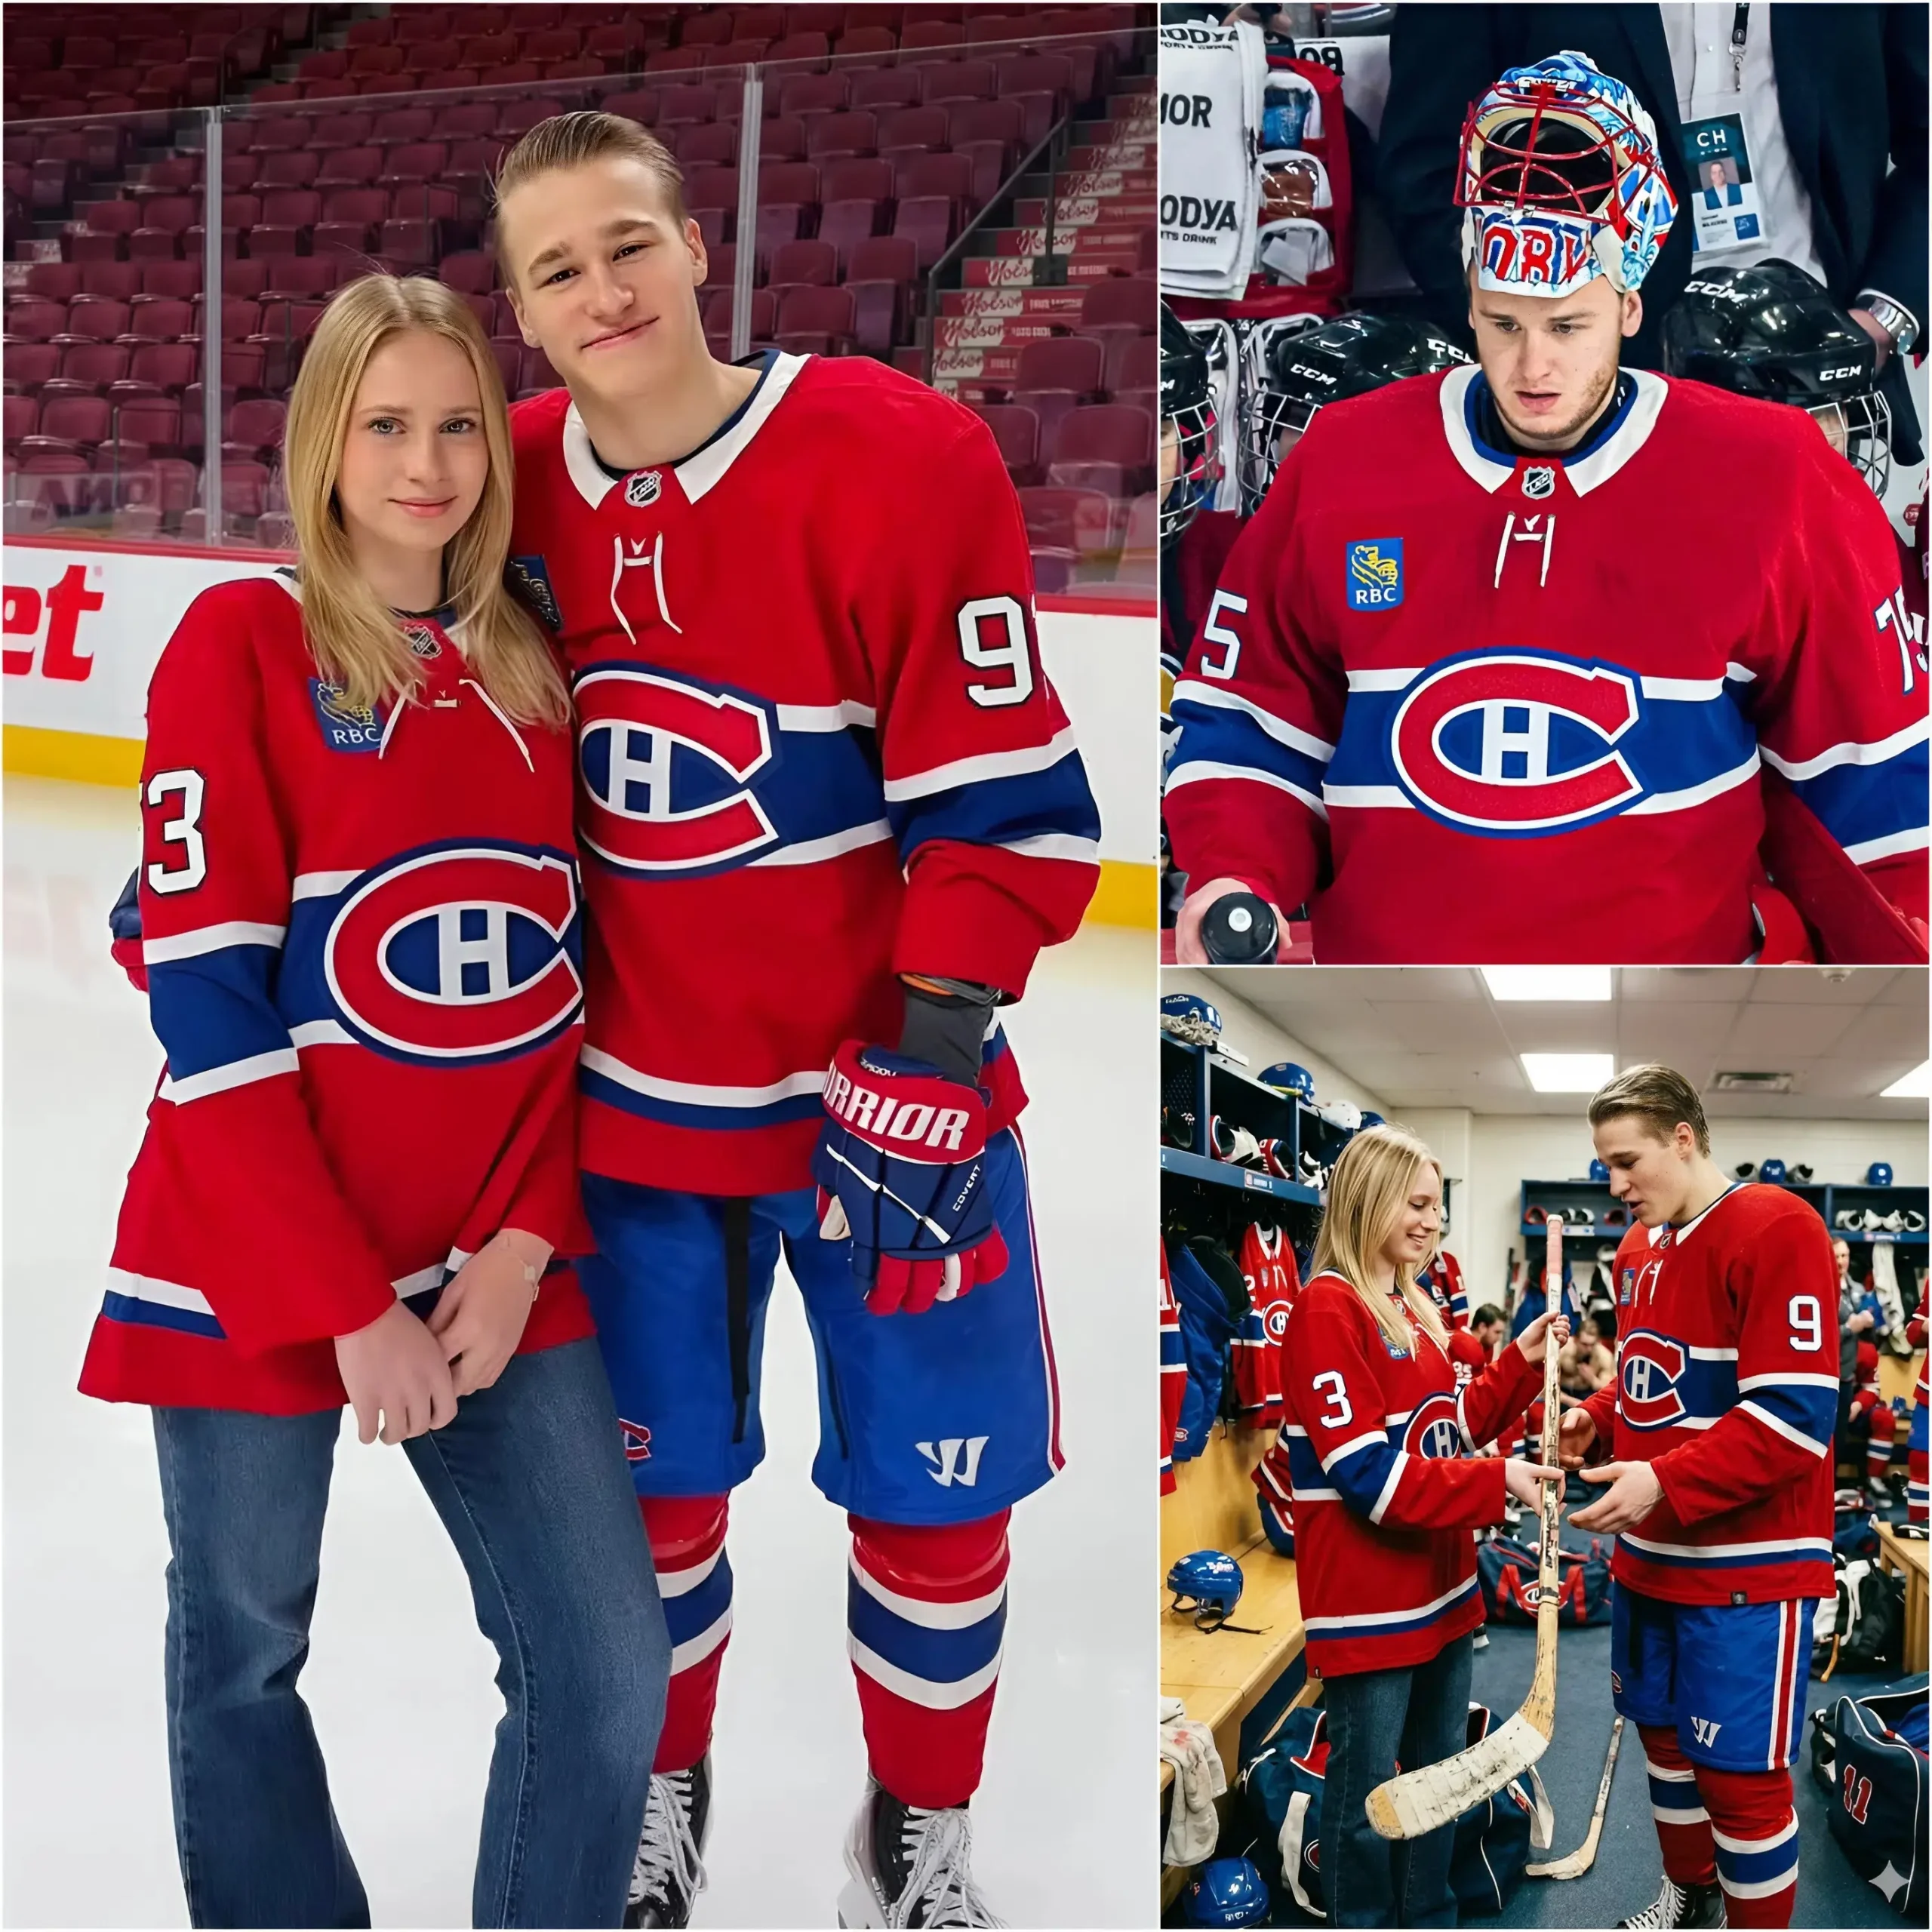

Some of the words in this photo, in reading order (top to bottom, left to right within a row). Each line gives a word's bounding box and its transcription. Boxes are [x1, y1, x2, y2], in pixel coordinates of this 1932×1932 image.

[1697, 128, 1727, 148] CH
[1290, 364, 1337, 386] CCM
[1820, 365, 1862, 381] CCM
[1356, 586, 1397, 605] RBC
[331, 728, 382, 744] RBC
[952, 1163, 980, 1212] COVERT
[1789, 1294, 1822, 1352] 9
[1312, 1370, 1354, 1429] 3
[1843, 1763, 1873, 1825] 11
